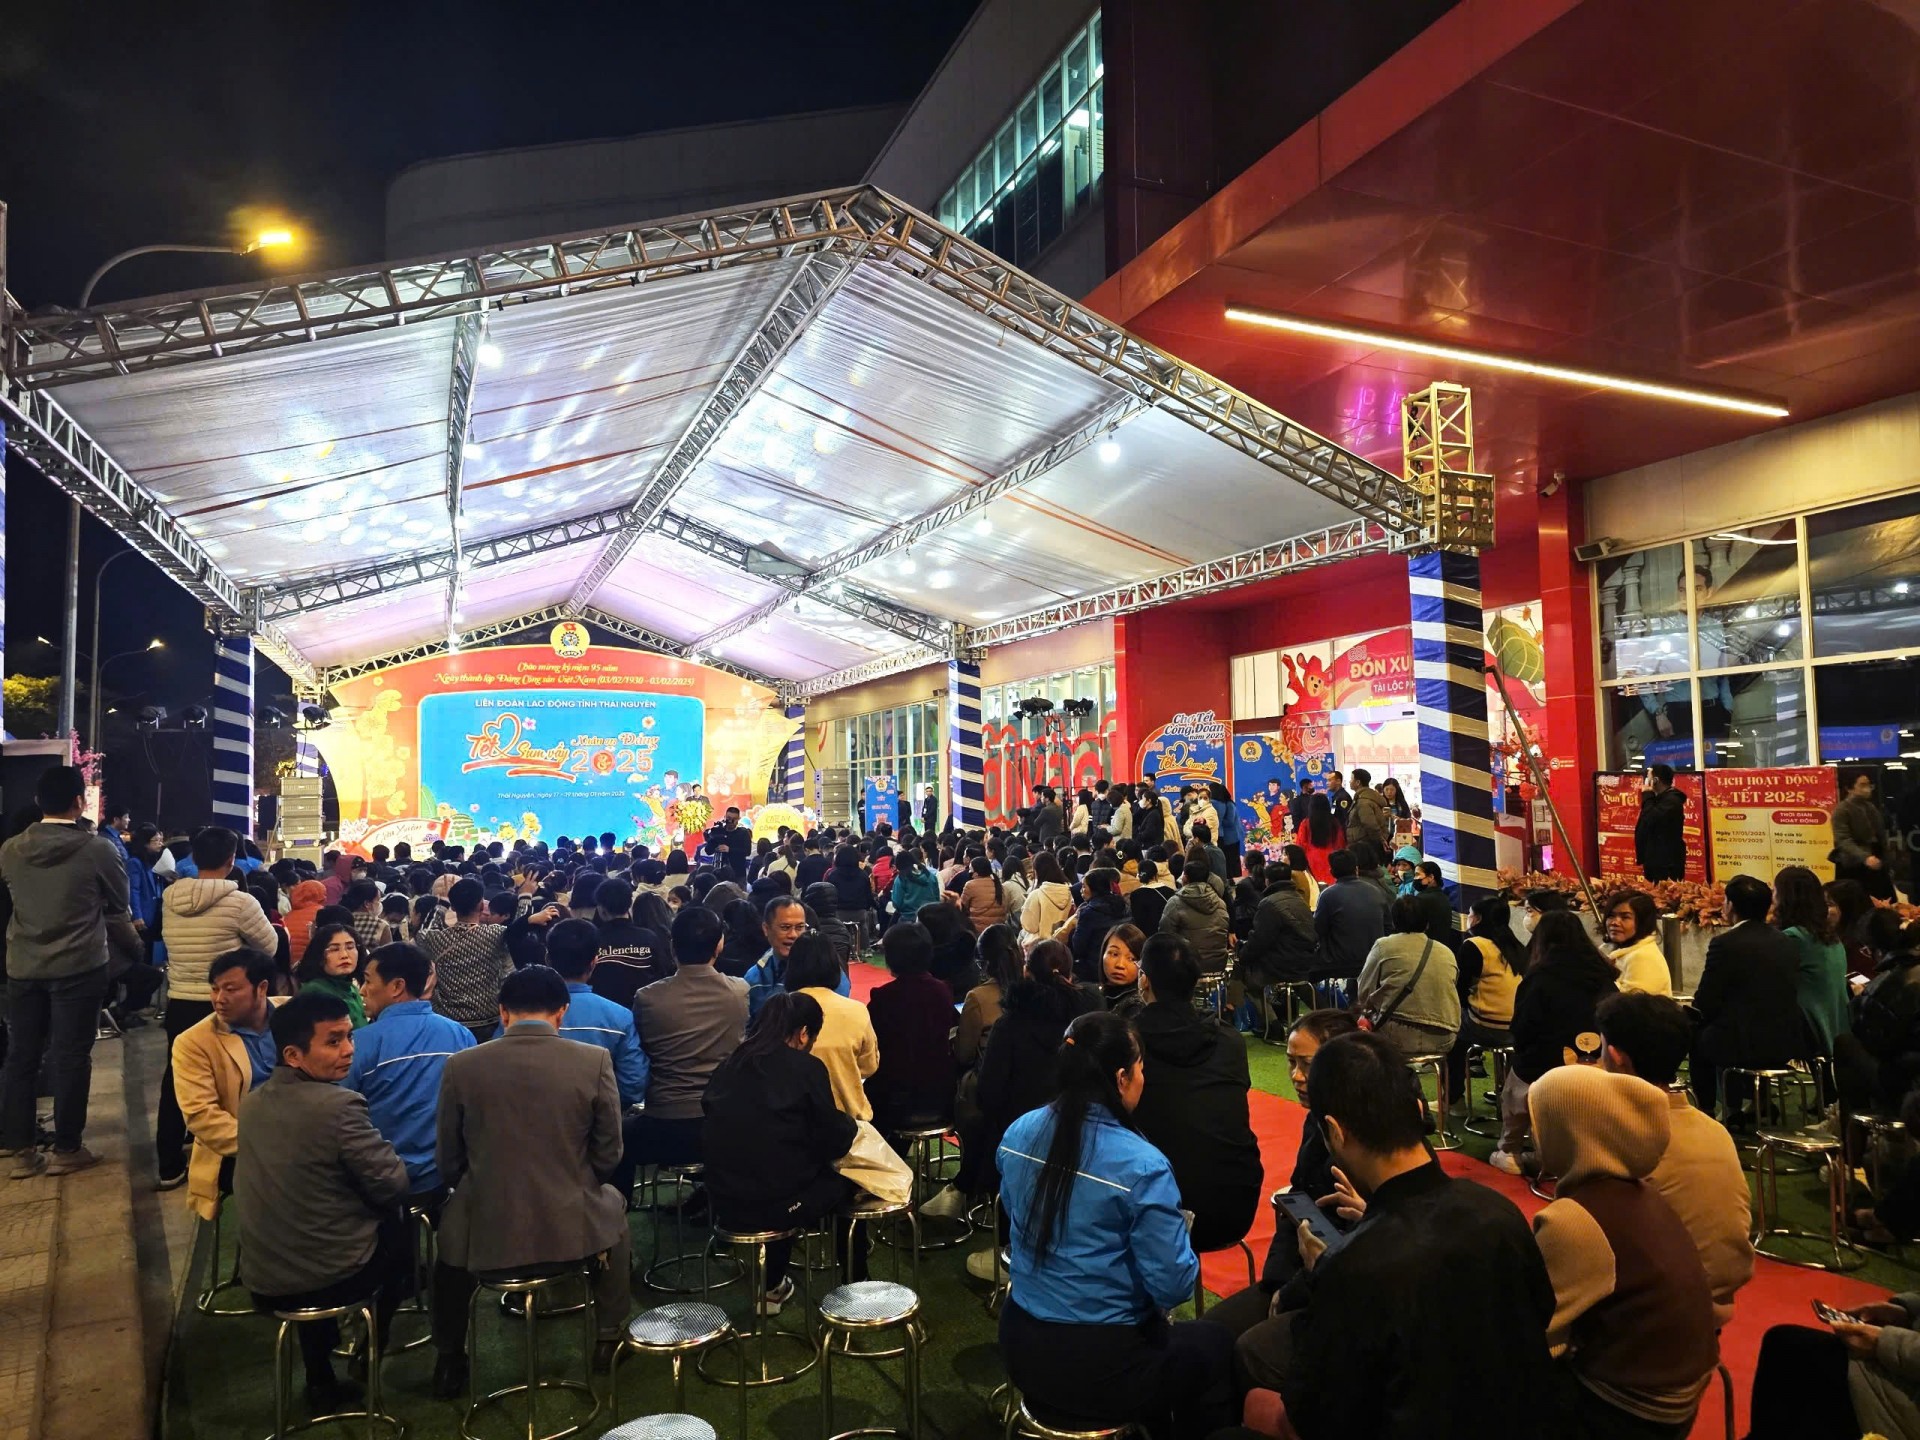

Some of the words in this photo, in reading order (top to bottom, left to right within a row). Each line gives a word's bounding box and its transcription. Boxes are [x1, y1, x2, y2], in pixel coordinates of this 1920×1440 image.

[1350, 657, 1386, 679] ĐÓN
[597, 675, 644, 684] (03/02/1930
[650, 677, 694, 686] 03/02/2025)
[1373, 682, 1386, 693] TÀI
[1388, 680, 1404, 693] LỘC
[475, 698, 495, 707] LIÊN
[497, 698, 524, 707] ĐOÀN
[527, 699, 545, 707] LAO
[547, 699, 576, 708] ĐỘNG
[621, 698, 656, 708] NGUYÊN
[1197, 710, 1214, 722] Tết
[467, 733, 499, 759] Tết
[518, 741, 544, 758] Sum
[547, 741, 569, 763] vầy
[1157, 753, 1176, 770] Tết
[1717, 776, 1743, 788] LỊCH
[1747, 776, 1780, 788] HOẠT
[1785, 774, 1818, 787] ĐỘNG
[1620, 791, 1640, 806] Tết
[1730, 787, 1761, 803] TẾT
[1764, 791, 1806, 803] 2025
